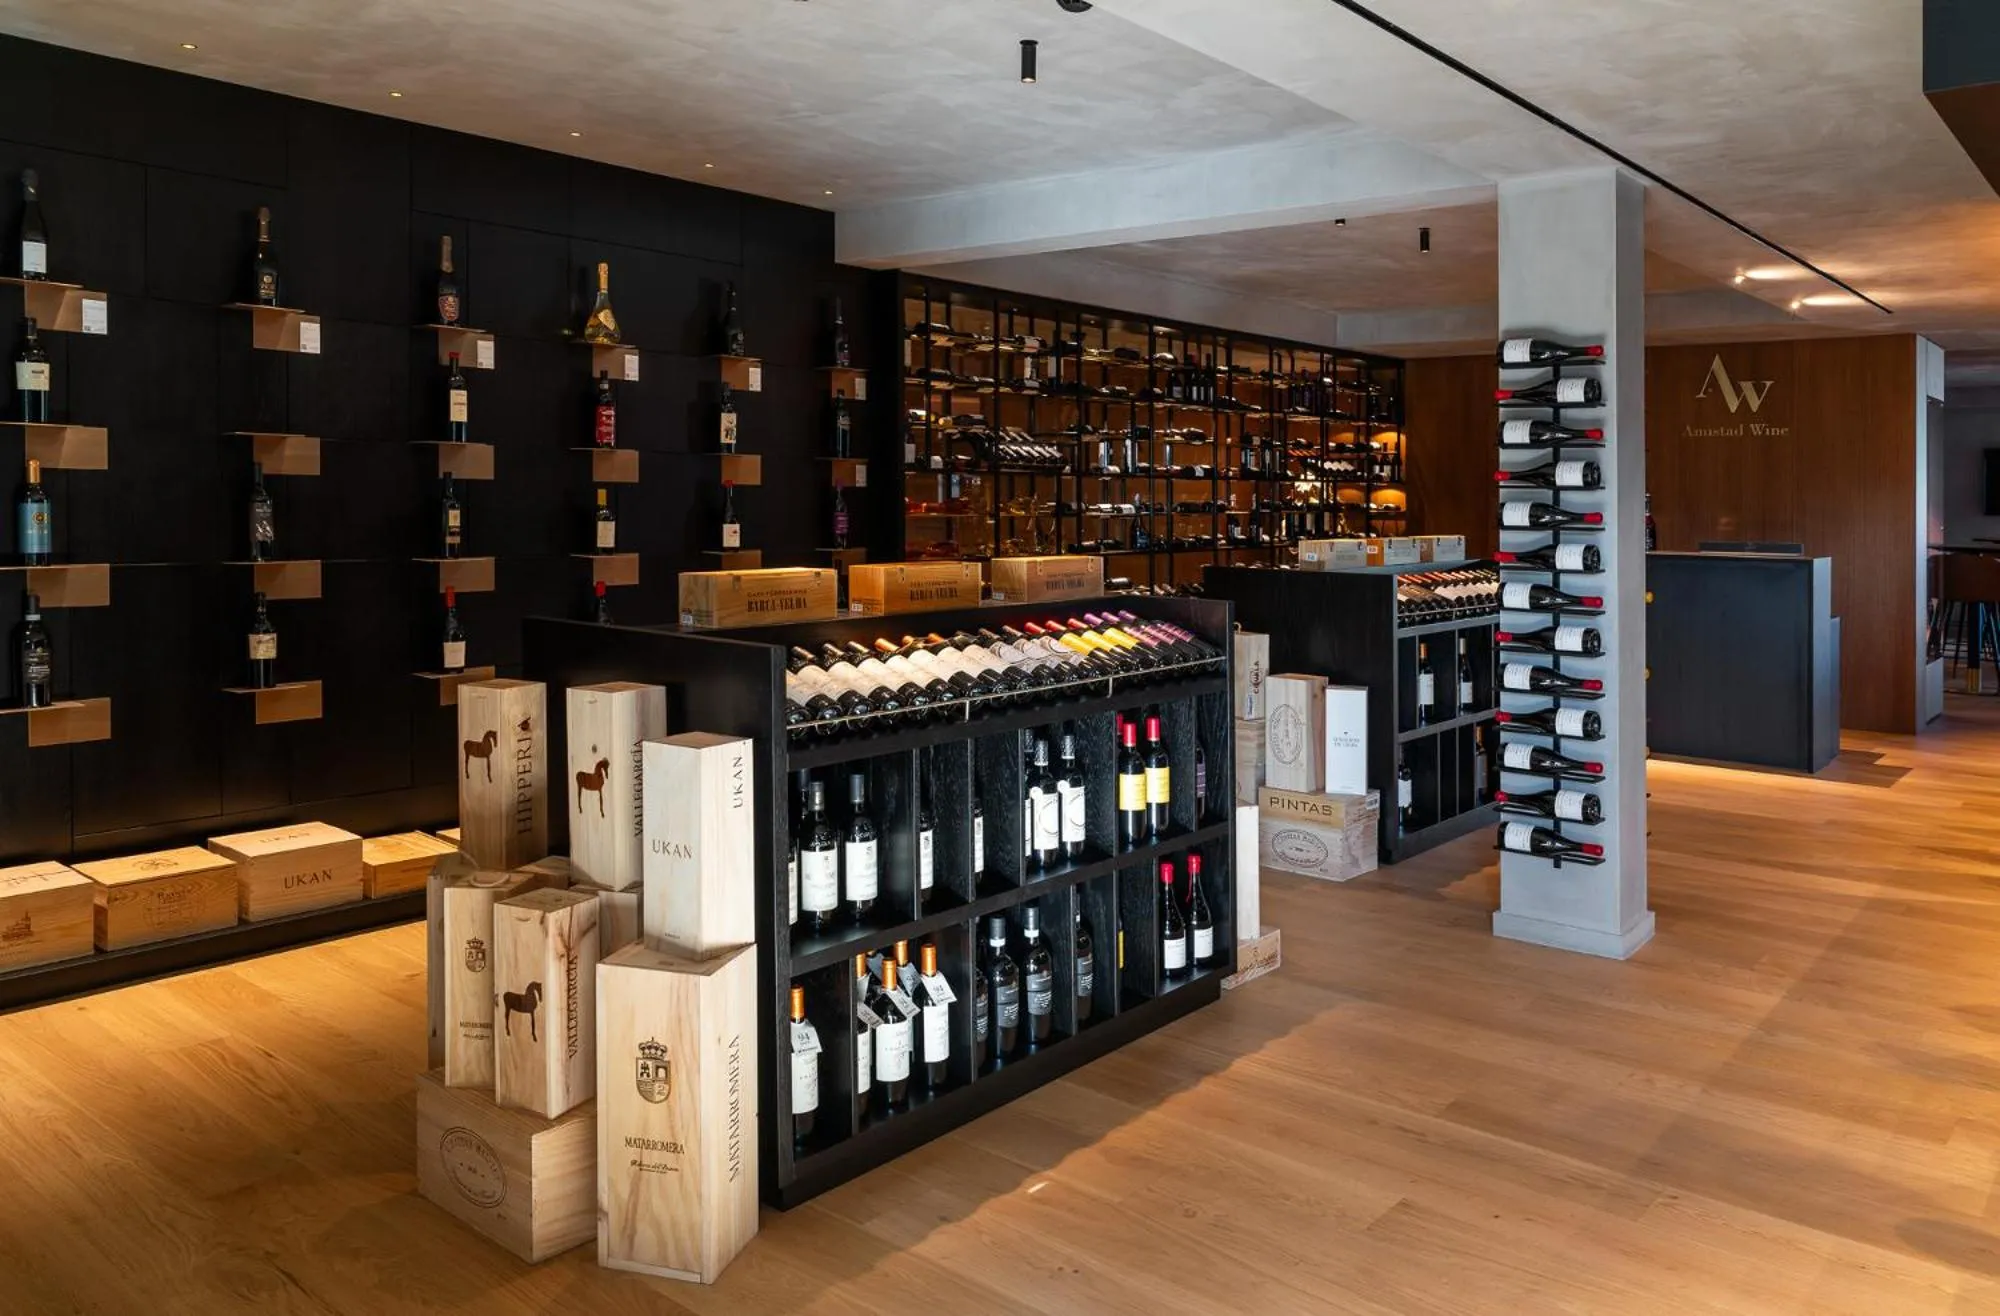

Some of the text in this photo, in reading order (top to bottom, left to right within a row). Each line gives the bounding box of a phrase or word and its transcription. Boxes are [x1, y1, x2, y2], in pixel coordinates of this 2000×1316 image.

[1682, 423, 1789, 437] Amistad Wine
[517, 715, 533, 836] HIPPERIA
[733, 755, 744, 809] UKAN
[1269, 796, 1333, 817] PINTAS
[651, 838, 693, 860] UKAN
[283, 868, 332, 890] UKAN
[728, 1033, 741, 1184] MATARROMERA
[624, 1135, 685, 1155] MATARROMERA
